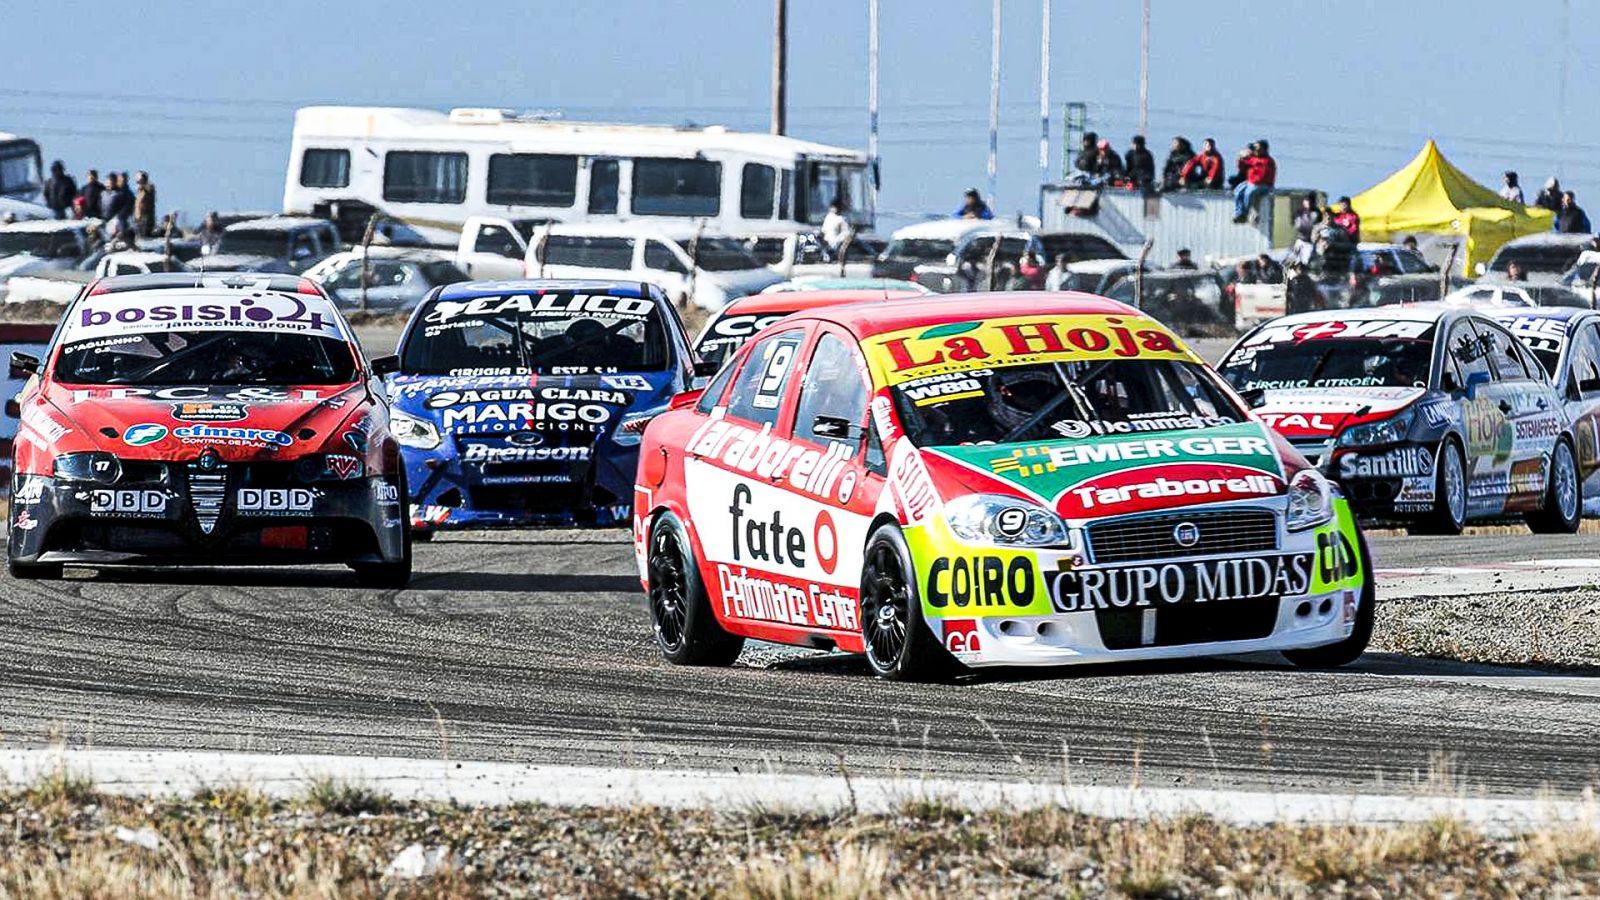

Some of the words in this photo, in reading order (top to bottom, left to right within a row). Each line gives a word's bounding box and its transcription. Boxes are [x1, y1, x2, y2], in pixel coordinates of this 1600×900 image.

[876, 337, 991, 373] La
[992, 317, 1187, 358] Hoja
[762, 345, 793, 391] 9
[1314, 377, 1385, 388] CITROËN
[460, 390, 534, 403] AGUA
[541, 387, 627, 405] CLARA
[443, 403, 610, 428] MARIGO
[1261, 413, 1335, 430] TAL
[173, 425, 294, 447] efmarco
[446, 421, 606, 435] PERFORACIONES
[182, 437, 222, 445] CONTROL
[464, 442, 592, 463] Brenson
[1340, 447, 1419, 478] Santilli
[239, 489, 312, 509] DBD
[1073, 475, 1278, 508] Taraborelli
[1002, 510, 1023, 534] 9
[926, 555, 1035, 608] COIRO
[1051, 563, 1185, 612] GRUPO
[1193, 554, 1310, 604] MIDAS
